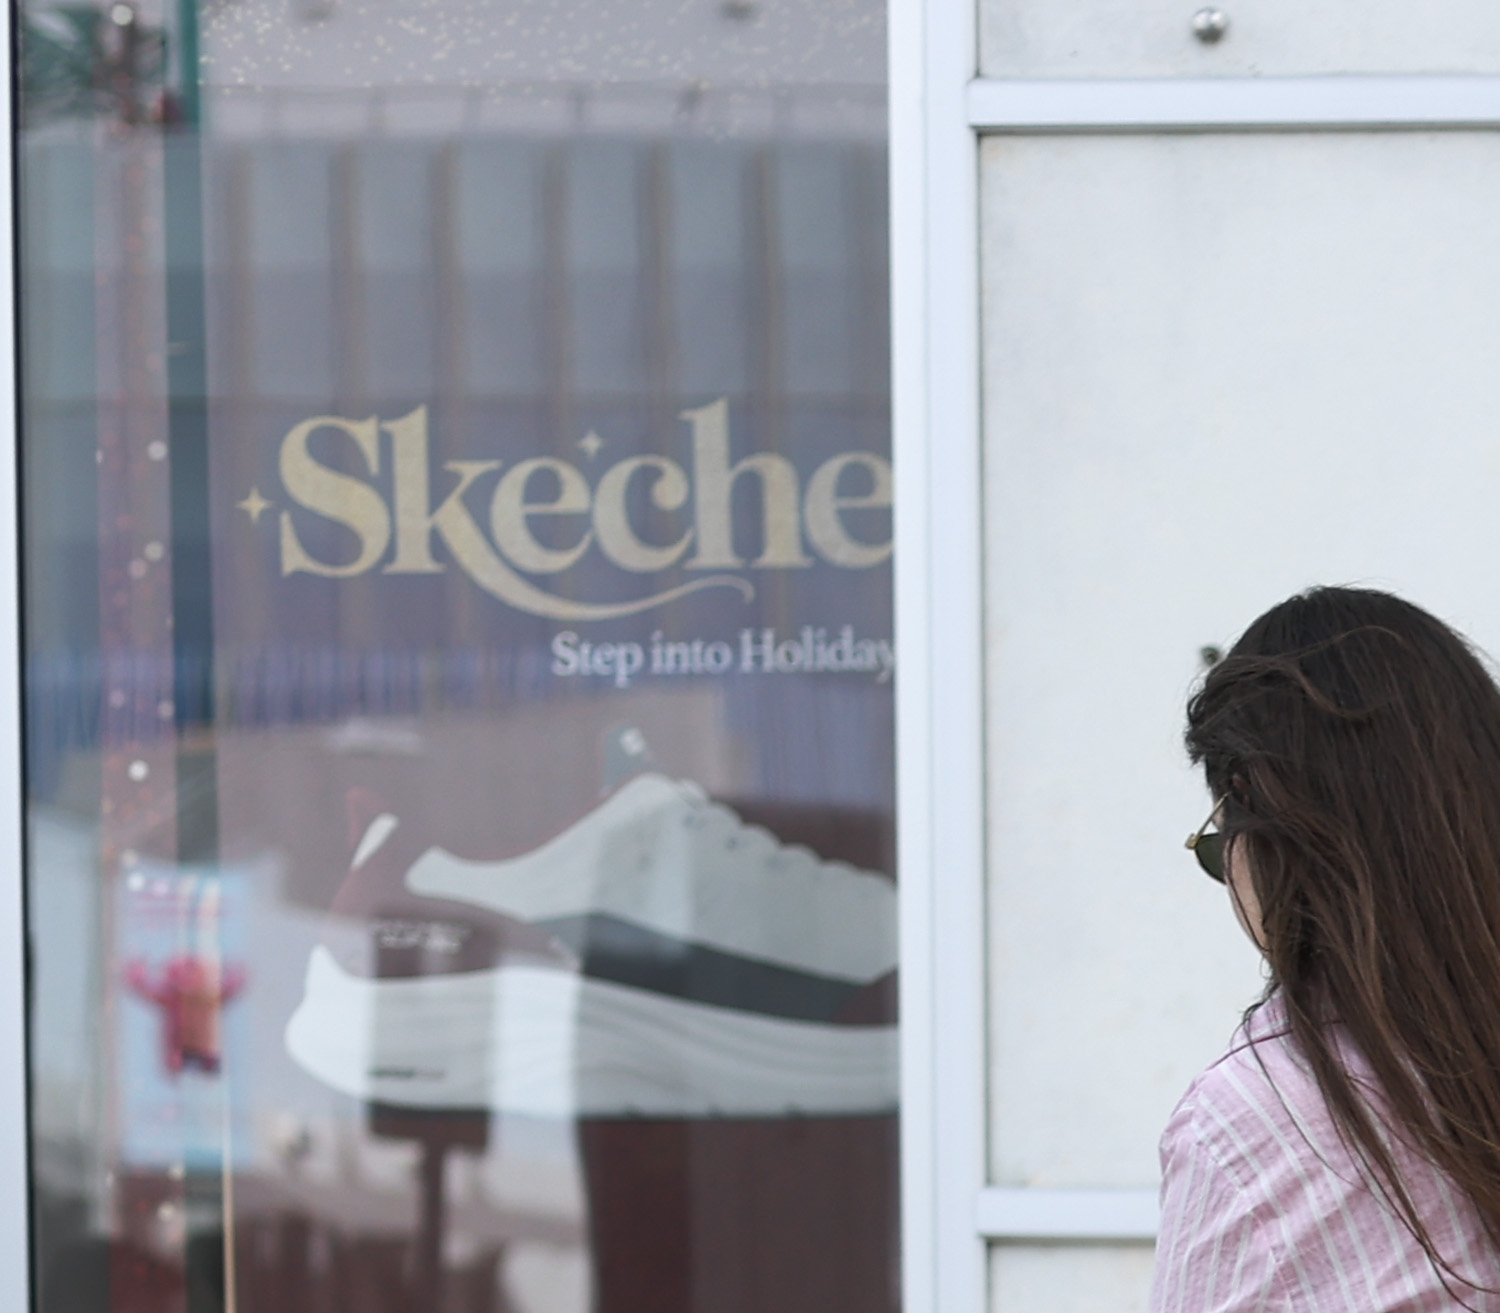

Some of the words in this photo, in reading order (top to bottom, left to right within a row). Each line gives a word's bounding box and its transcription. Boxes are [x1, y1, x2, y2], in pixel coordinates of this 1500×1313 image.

[279, 398, 894, 621] Skeche
[551, 631, 643, 688] Step
[652, 630, 733, 675] into
[740, 625, 895, 683] Holiday
